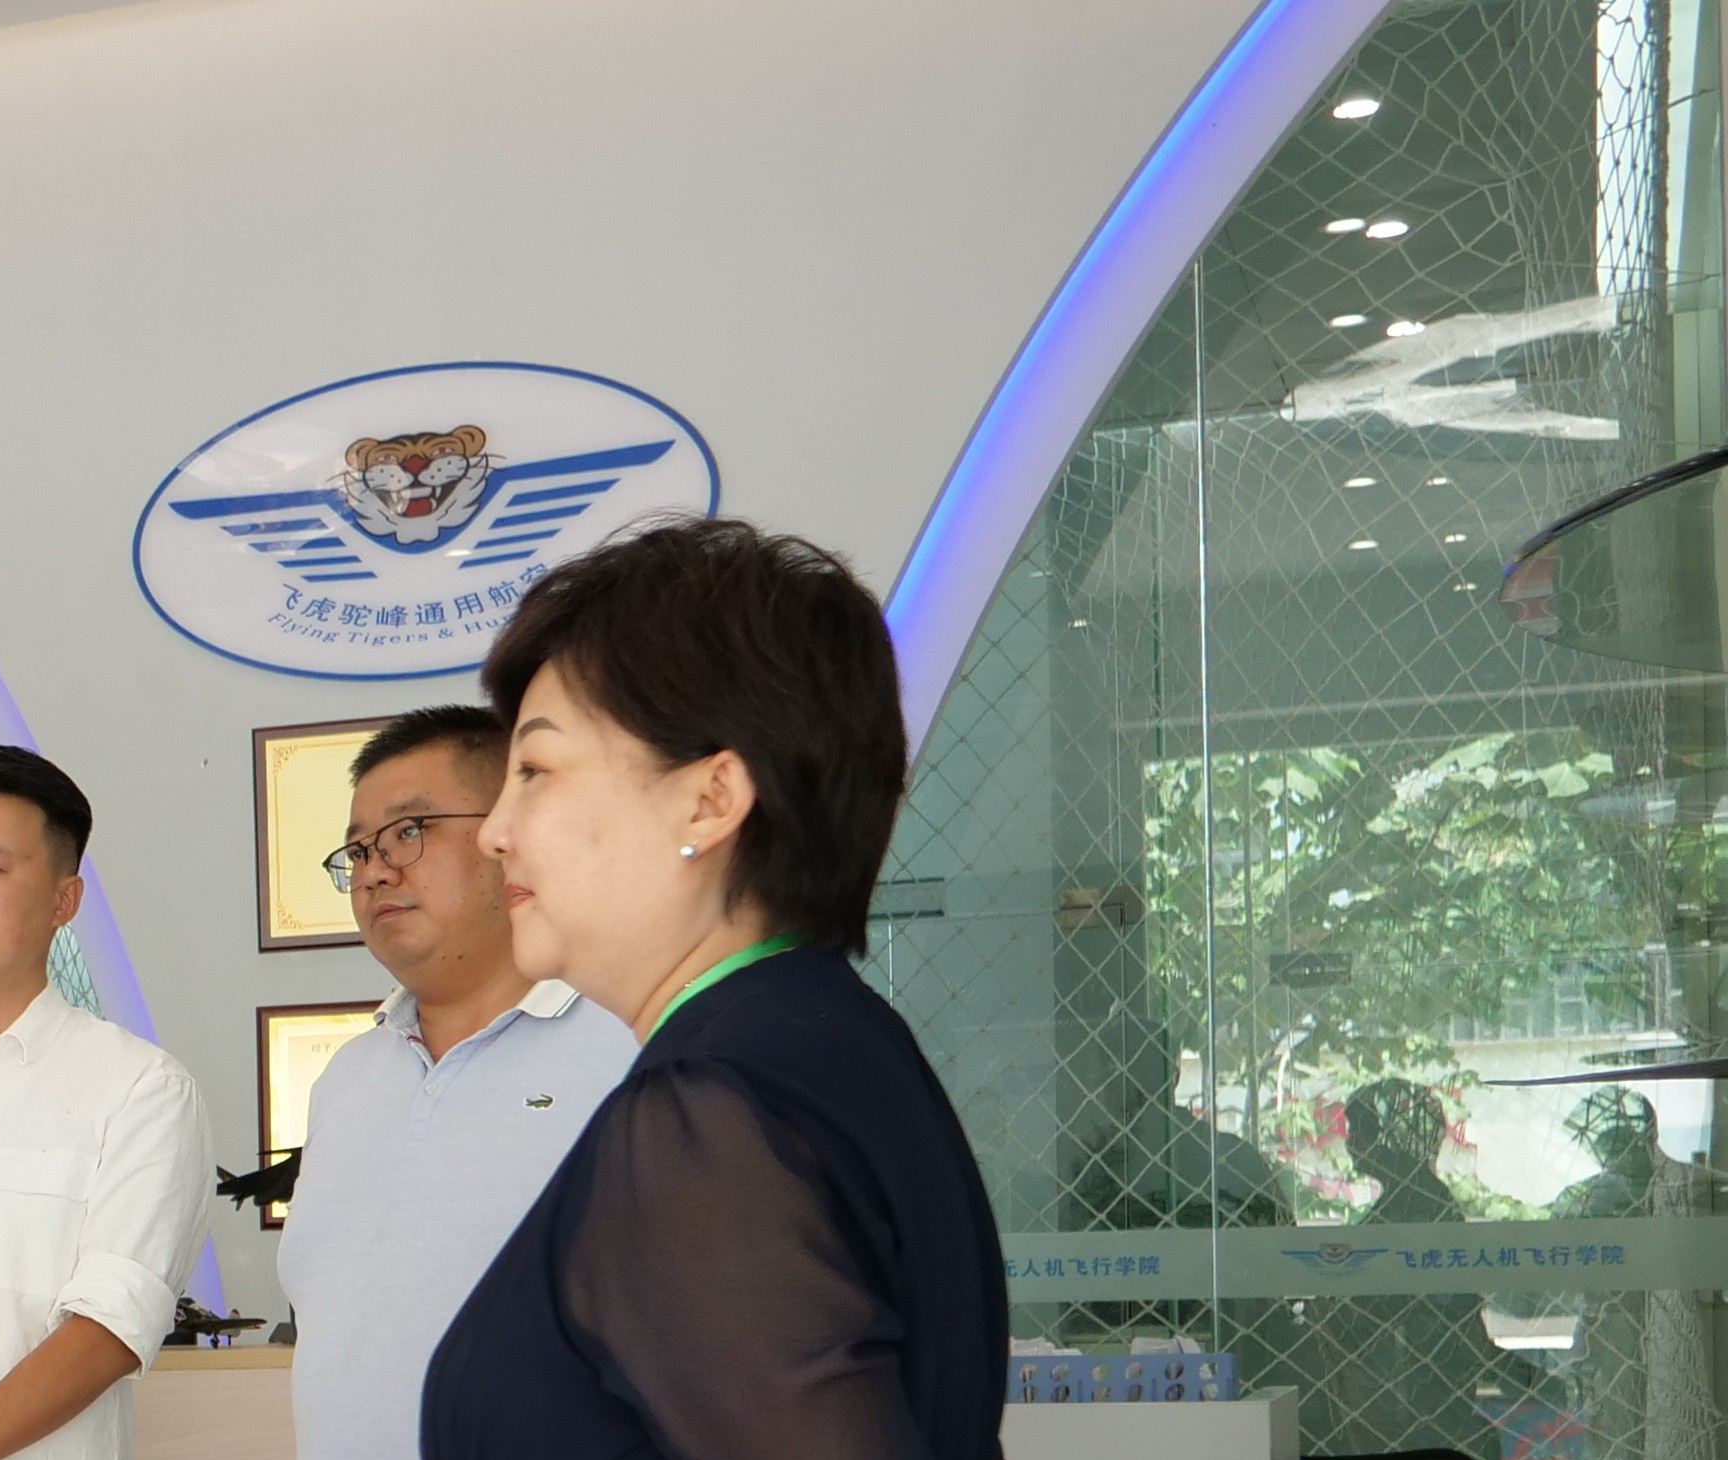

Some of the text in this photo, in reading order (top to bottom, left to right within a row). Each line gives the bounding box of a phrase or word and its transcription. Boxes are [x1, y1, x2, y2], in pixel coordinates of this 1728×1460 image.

[268, 612, 340, 644] Flying
[347, 630, 429, 646] Tigers
[438, 627, 455, 640] &
[1396, 1245, 1626, 1269] 飞虎无人机飞行学院
